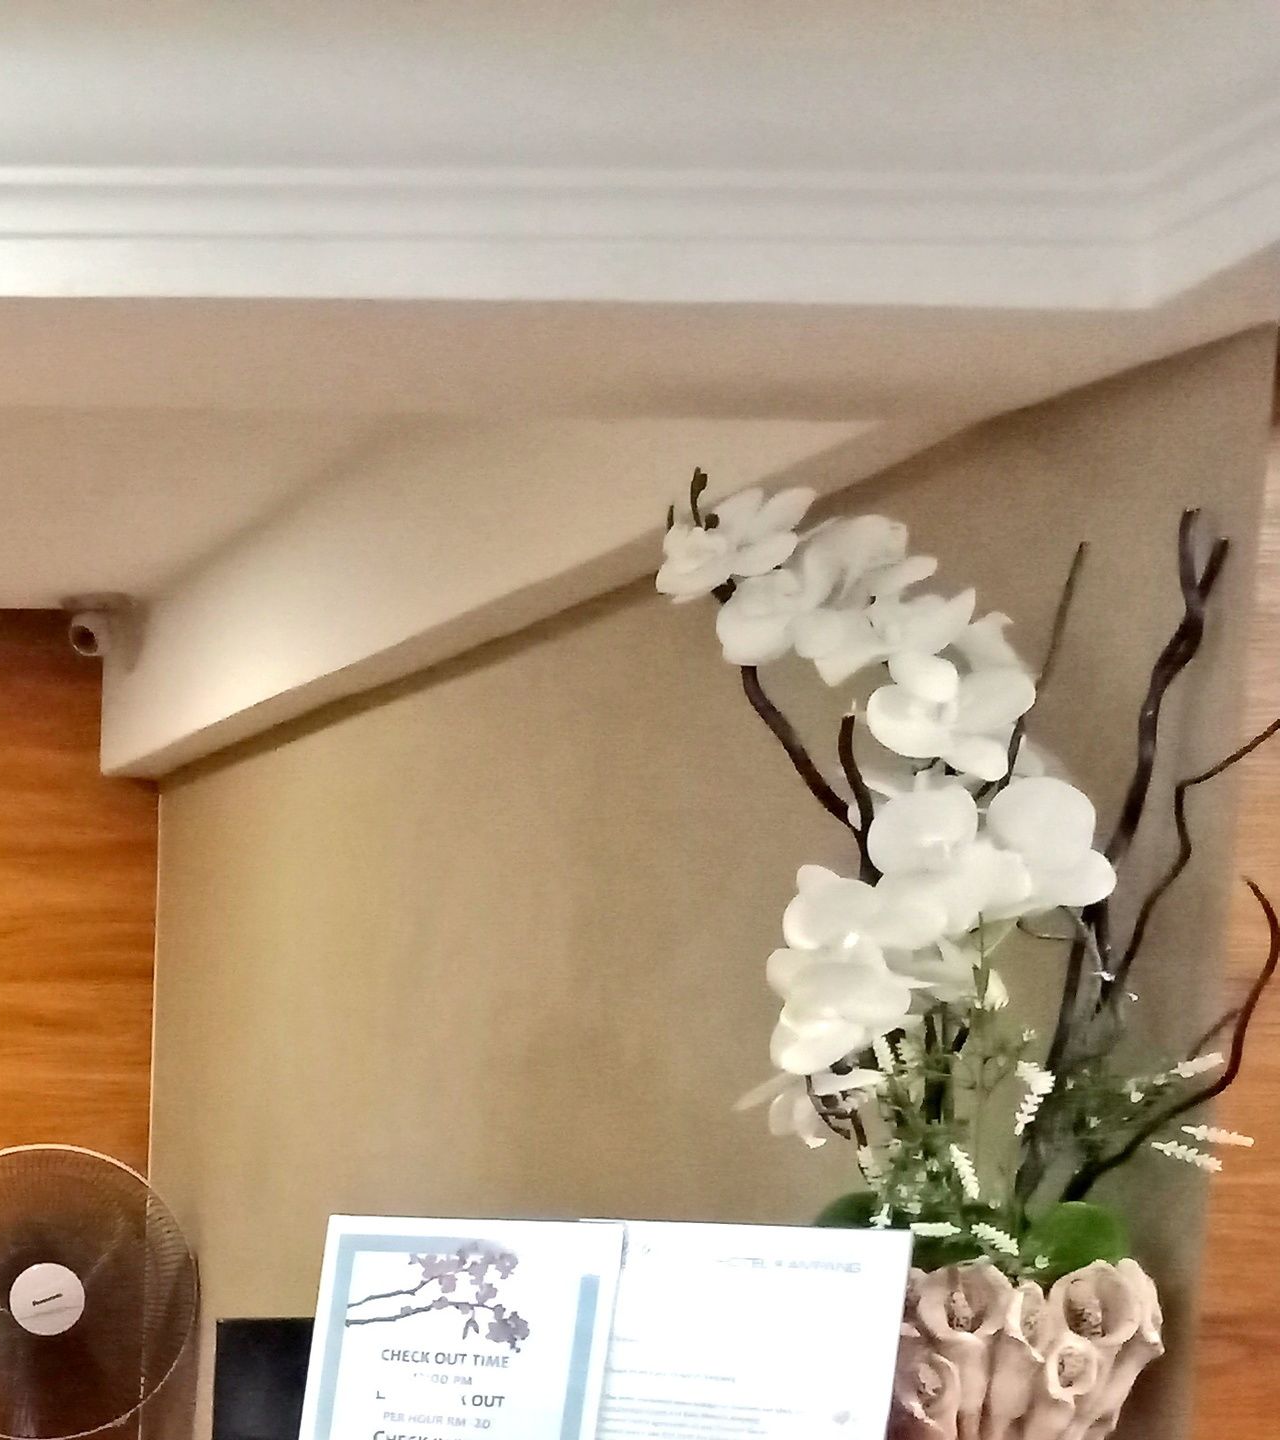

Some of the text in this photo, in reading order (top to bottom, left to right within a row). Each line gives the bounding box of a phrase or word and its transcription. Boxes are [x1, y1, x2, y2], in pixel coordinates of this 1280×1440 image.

[381, 1348, 510, 1369] CHECK OUT TIME
[471, 1394, 505, 1408] OUT
[383, 1411, 405, 1423] PER
[408, 1414, 444, 1427] HOUR
[446, 1416, 467, 1428] RM
